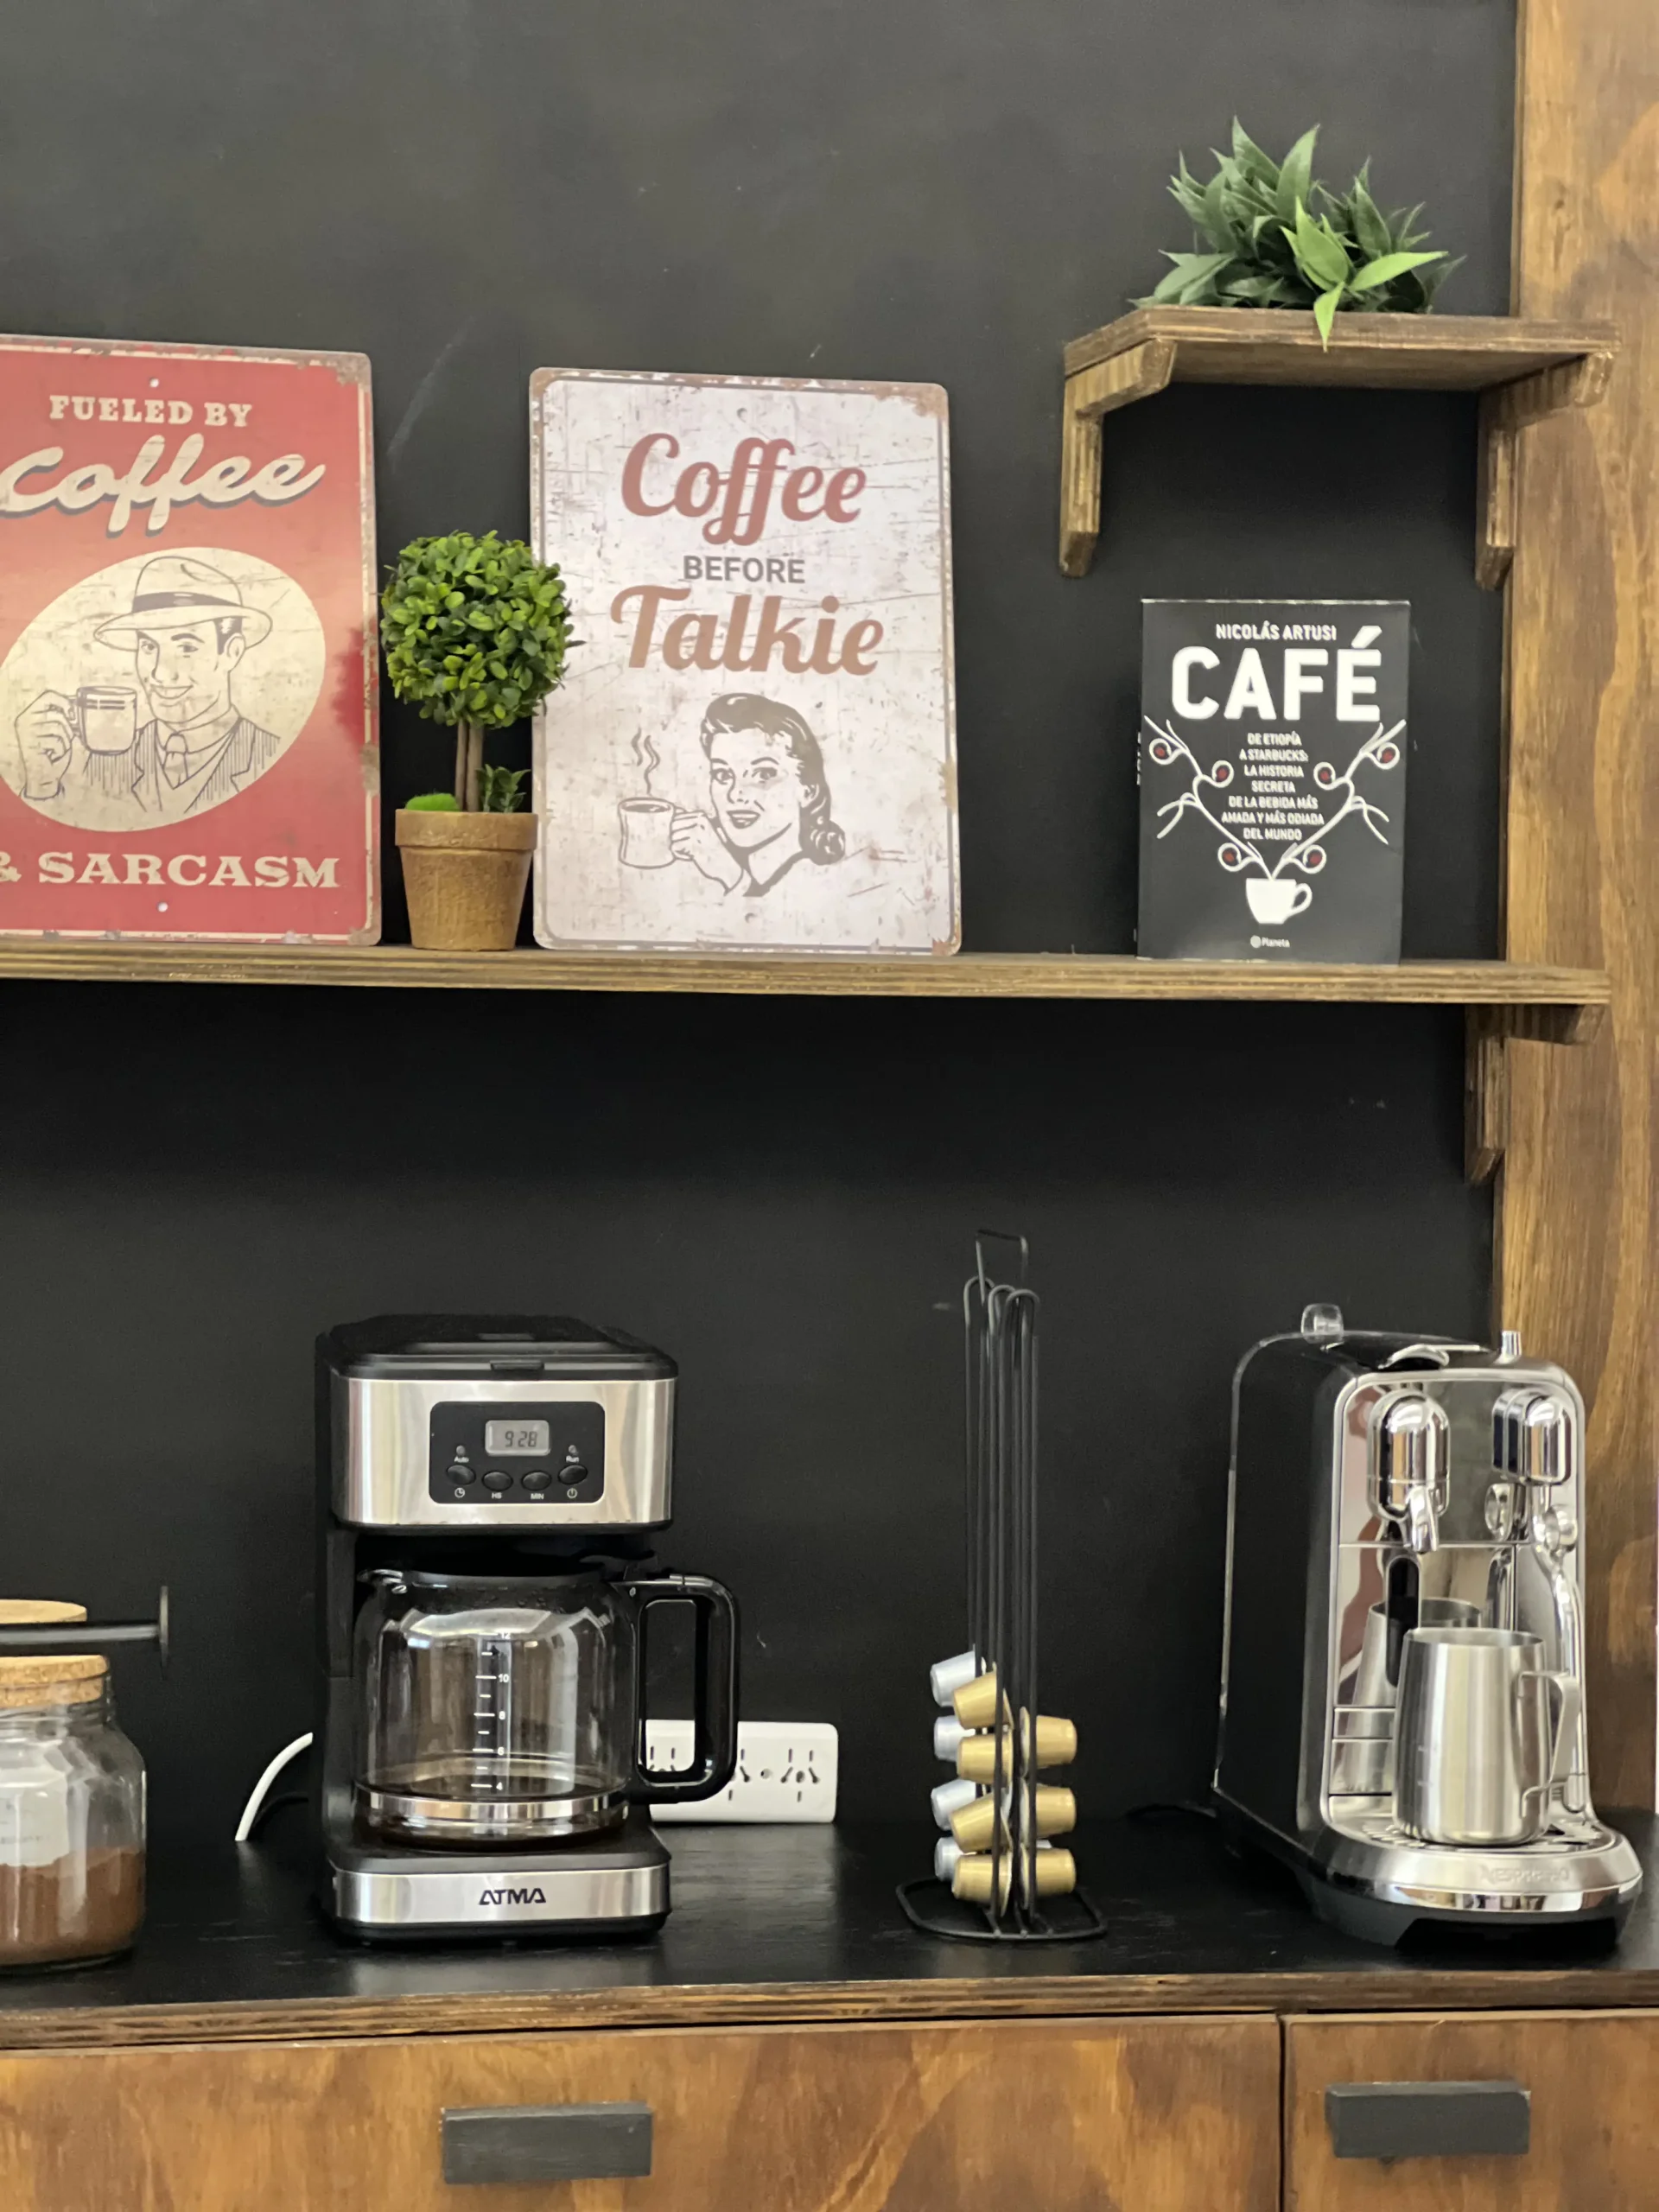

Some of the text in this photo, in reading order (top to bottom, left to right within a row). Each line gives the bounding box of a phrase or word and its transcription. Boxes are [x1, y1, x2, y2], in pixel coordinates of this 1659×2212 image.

[49, 395, 253, 427] FUELED BY
[620, 432, 865, 546] Coffee
[683, 555, 805, 584] BEFORE
[610, 584, 883, 676] Talkie
[1216, 620, 1337, 641] NICOLÁS ARTUSI
[1172, 625, 1382, 721] CAFÉ
[1247, 733, 1262, 746] DE
[1238, 748, 1247, 760] A
[1244, 764, 1304, 778] LA HISTORIA
[1251, 779, 1296, 793] SECRETA
[1229, 794, 1319, 810] DE LA BEBIDA MÁS
[1221, 810, 1325, 825] AMADA Y MÁS ODIADA
[1243, 827, 1303, 841] DEL MUNDO
[38, 851, 341, 887] SARCASM
[501, 1631, 511, 1640] 12
[498, 1673, 510, 1683] 10
[495, 1782, 504, 1791] 4
[479, 1888, 547, 1905] ATMA
